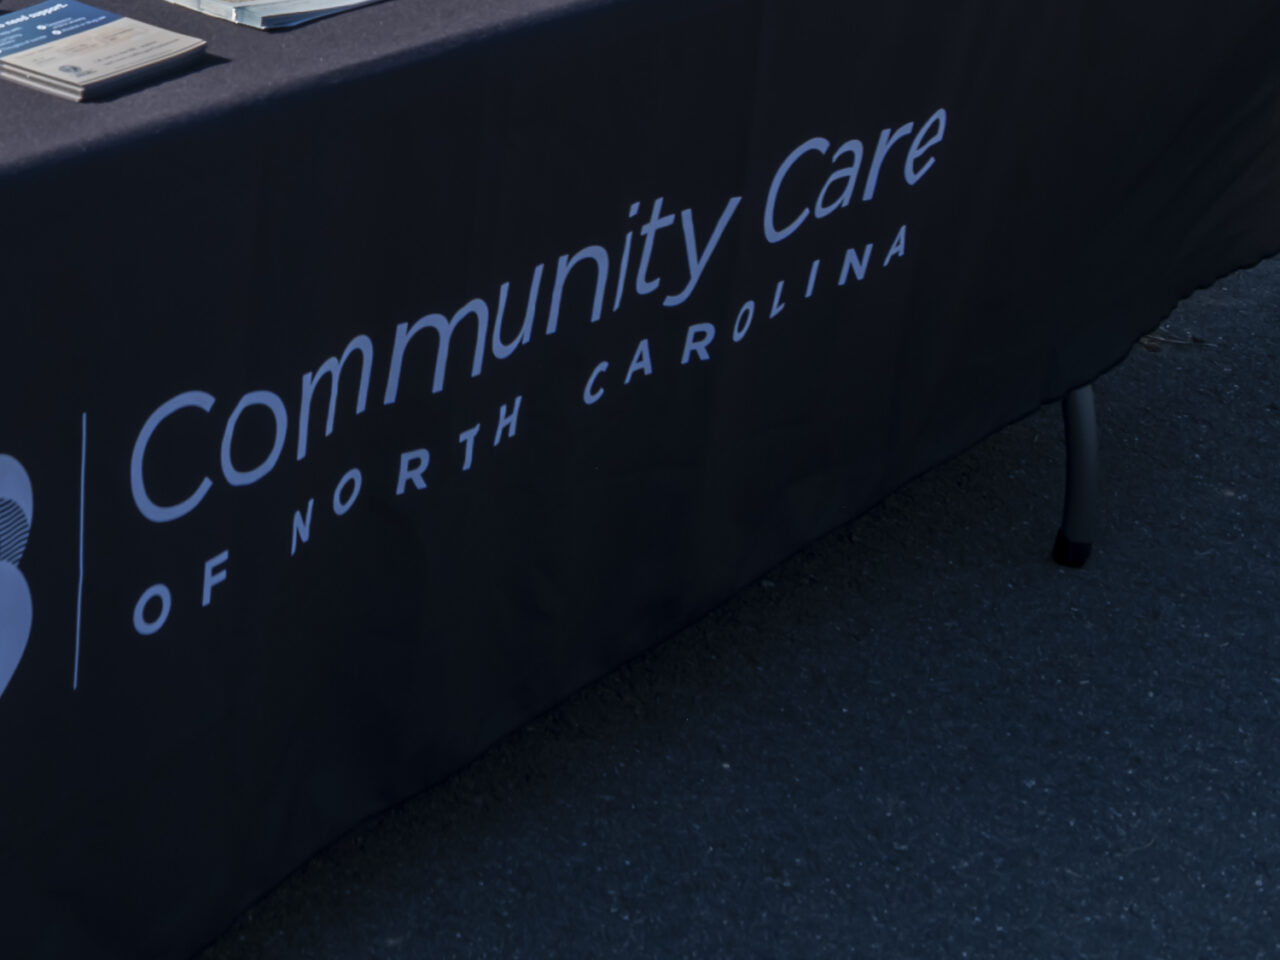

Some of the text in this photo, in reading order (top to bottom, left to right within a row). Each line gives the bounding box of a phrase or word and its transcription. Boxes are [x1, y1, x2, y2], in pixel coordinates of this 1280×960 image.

[131, 108, 947, 523] Community Care
[133, 224, 907, 636] OF NORTH CAROLINA
